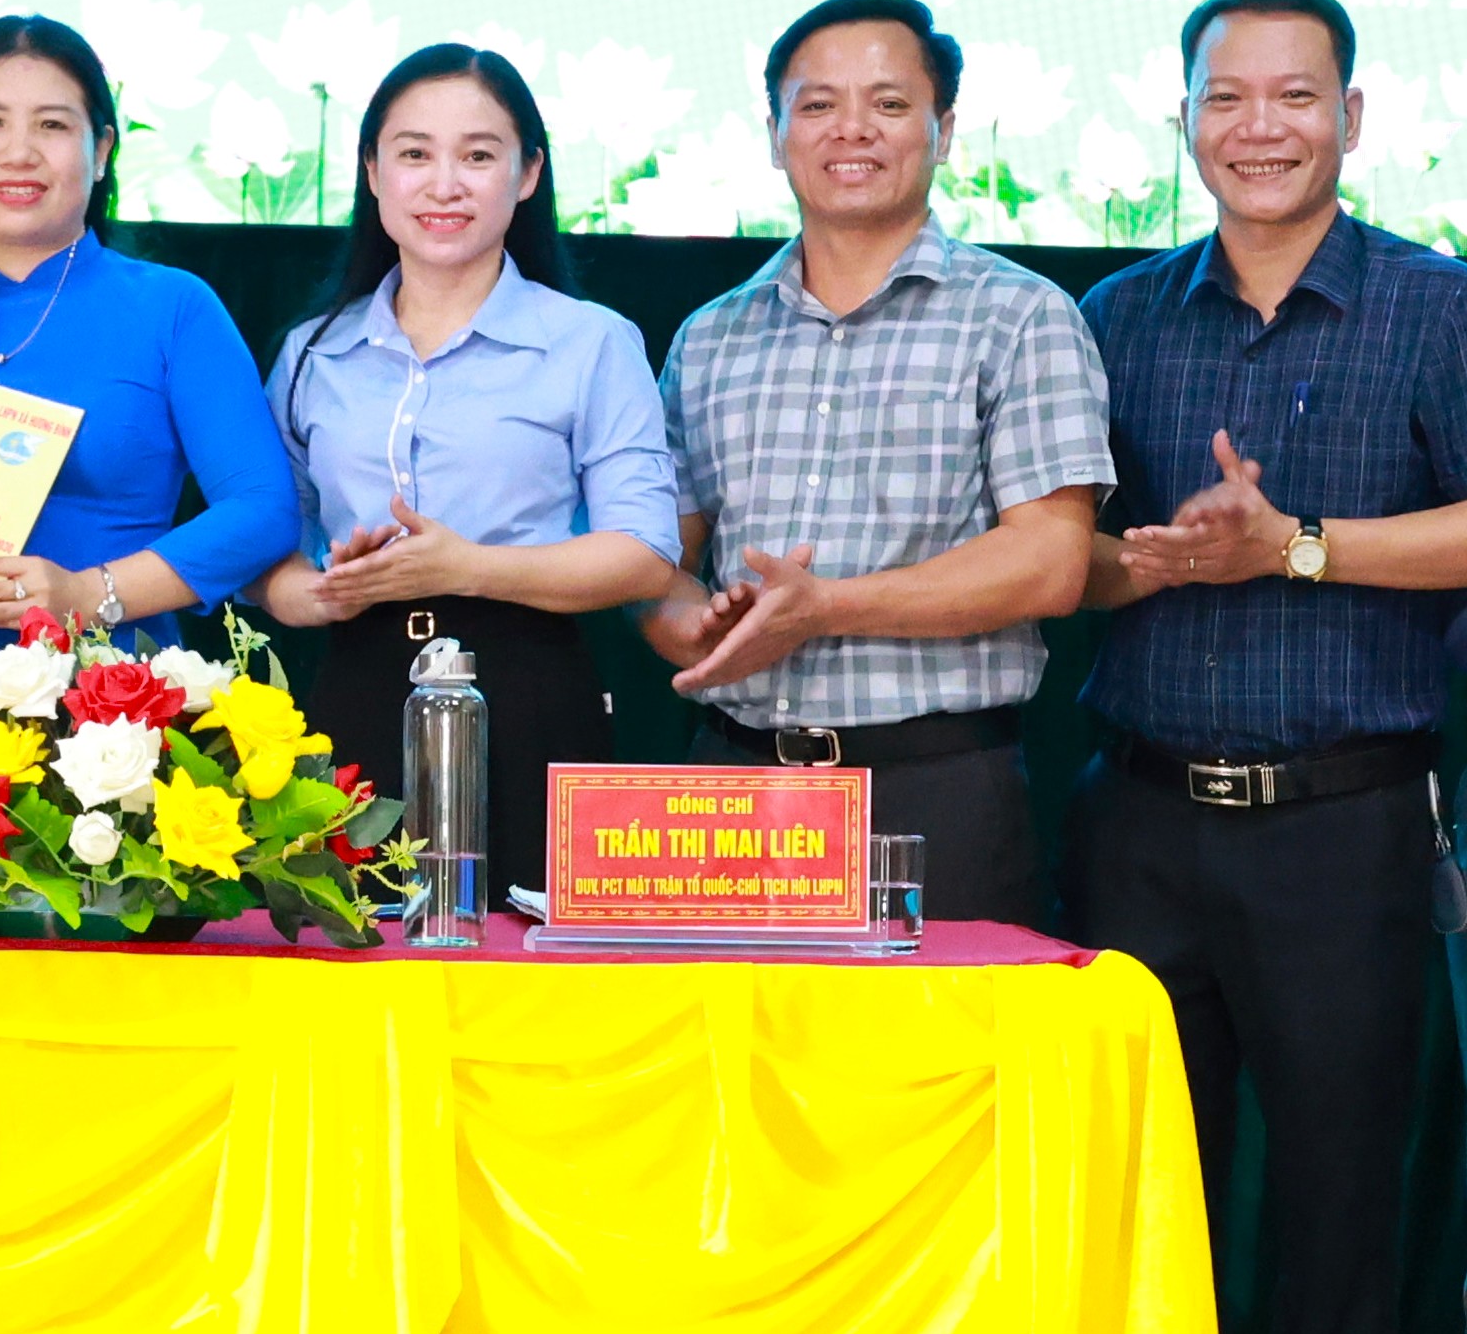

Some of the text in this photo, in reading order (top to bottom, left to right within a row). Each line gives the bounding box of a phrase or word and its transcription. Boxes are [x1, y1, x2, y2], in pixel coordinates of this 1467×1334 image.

[722, 793, 754, 815] CHÍ
[593, 818, 826, 865] TRẦN THỊ MAI LIÊN
[601, 877, 624, 896] PCT
[790, 874, 811, 900] HỘI
